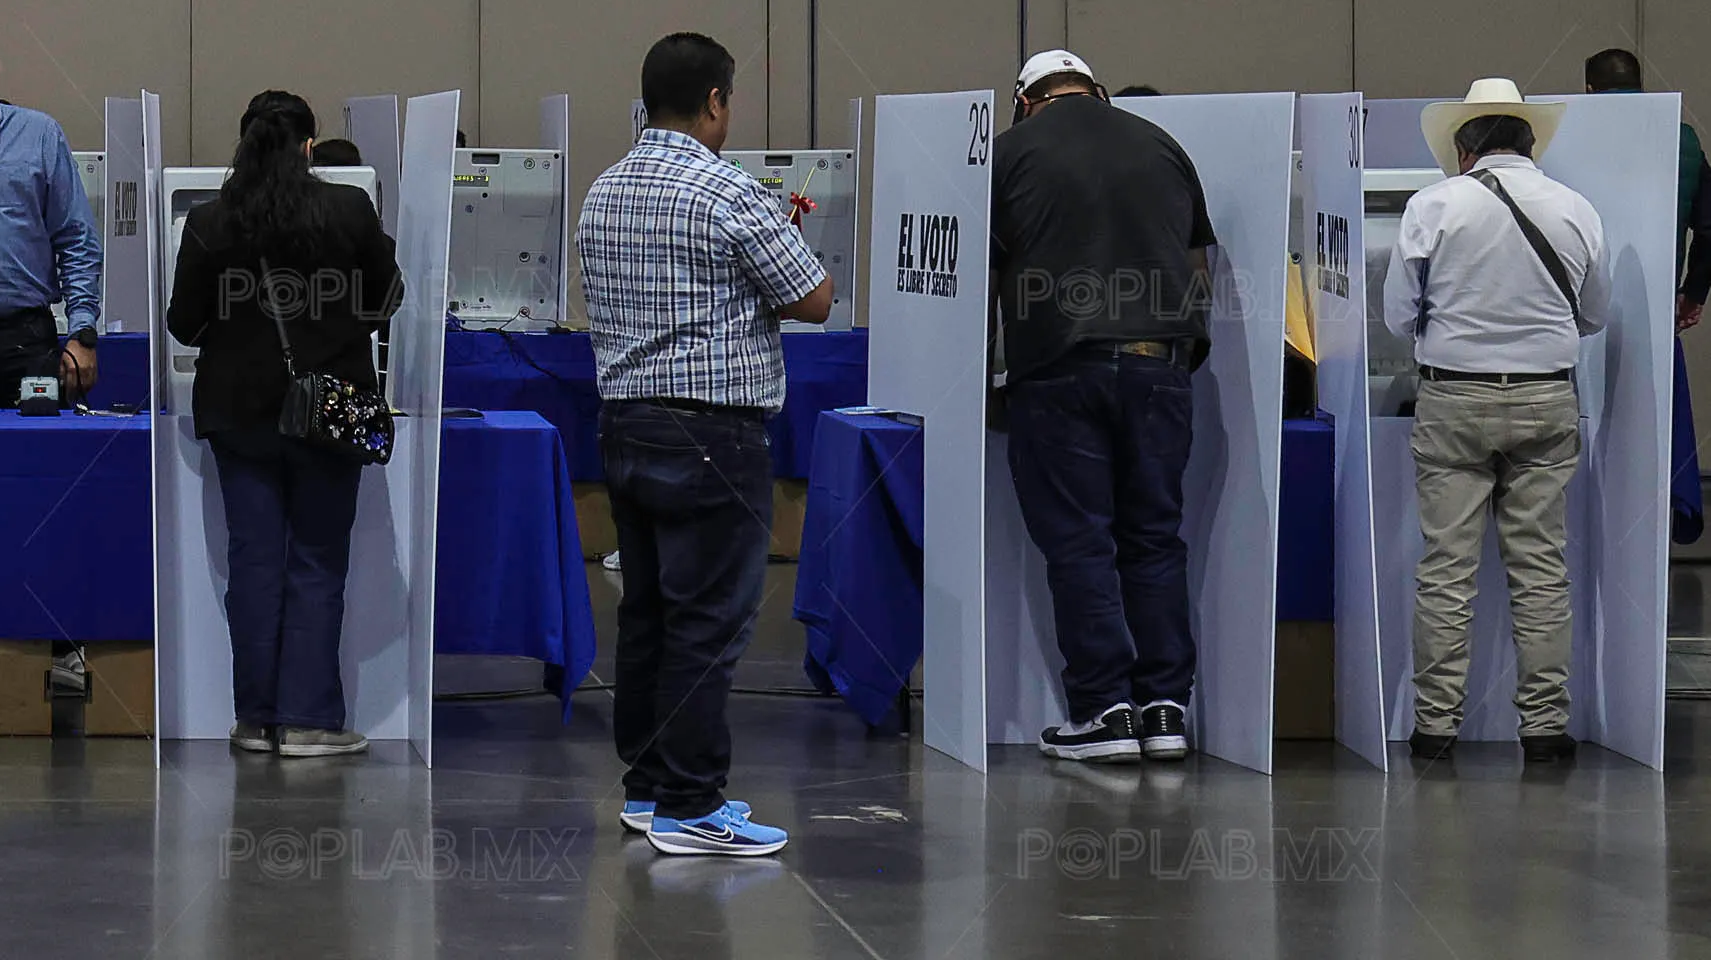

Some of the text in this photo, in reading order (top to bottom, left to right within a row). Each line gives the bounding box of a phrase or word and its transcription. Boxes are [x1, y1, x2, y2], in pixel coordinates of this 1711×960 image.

[968, 102, 990, 166] 29
[898, 213, 959, 274] EL VOTO
[1317, 211, 1349, 276] EL VOTO
[897, 268, 957, 298] ES LIBRE Y SECRETO
